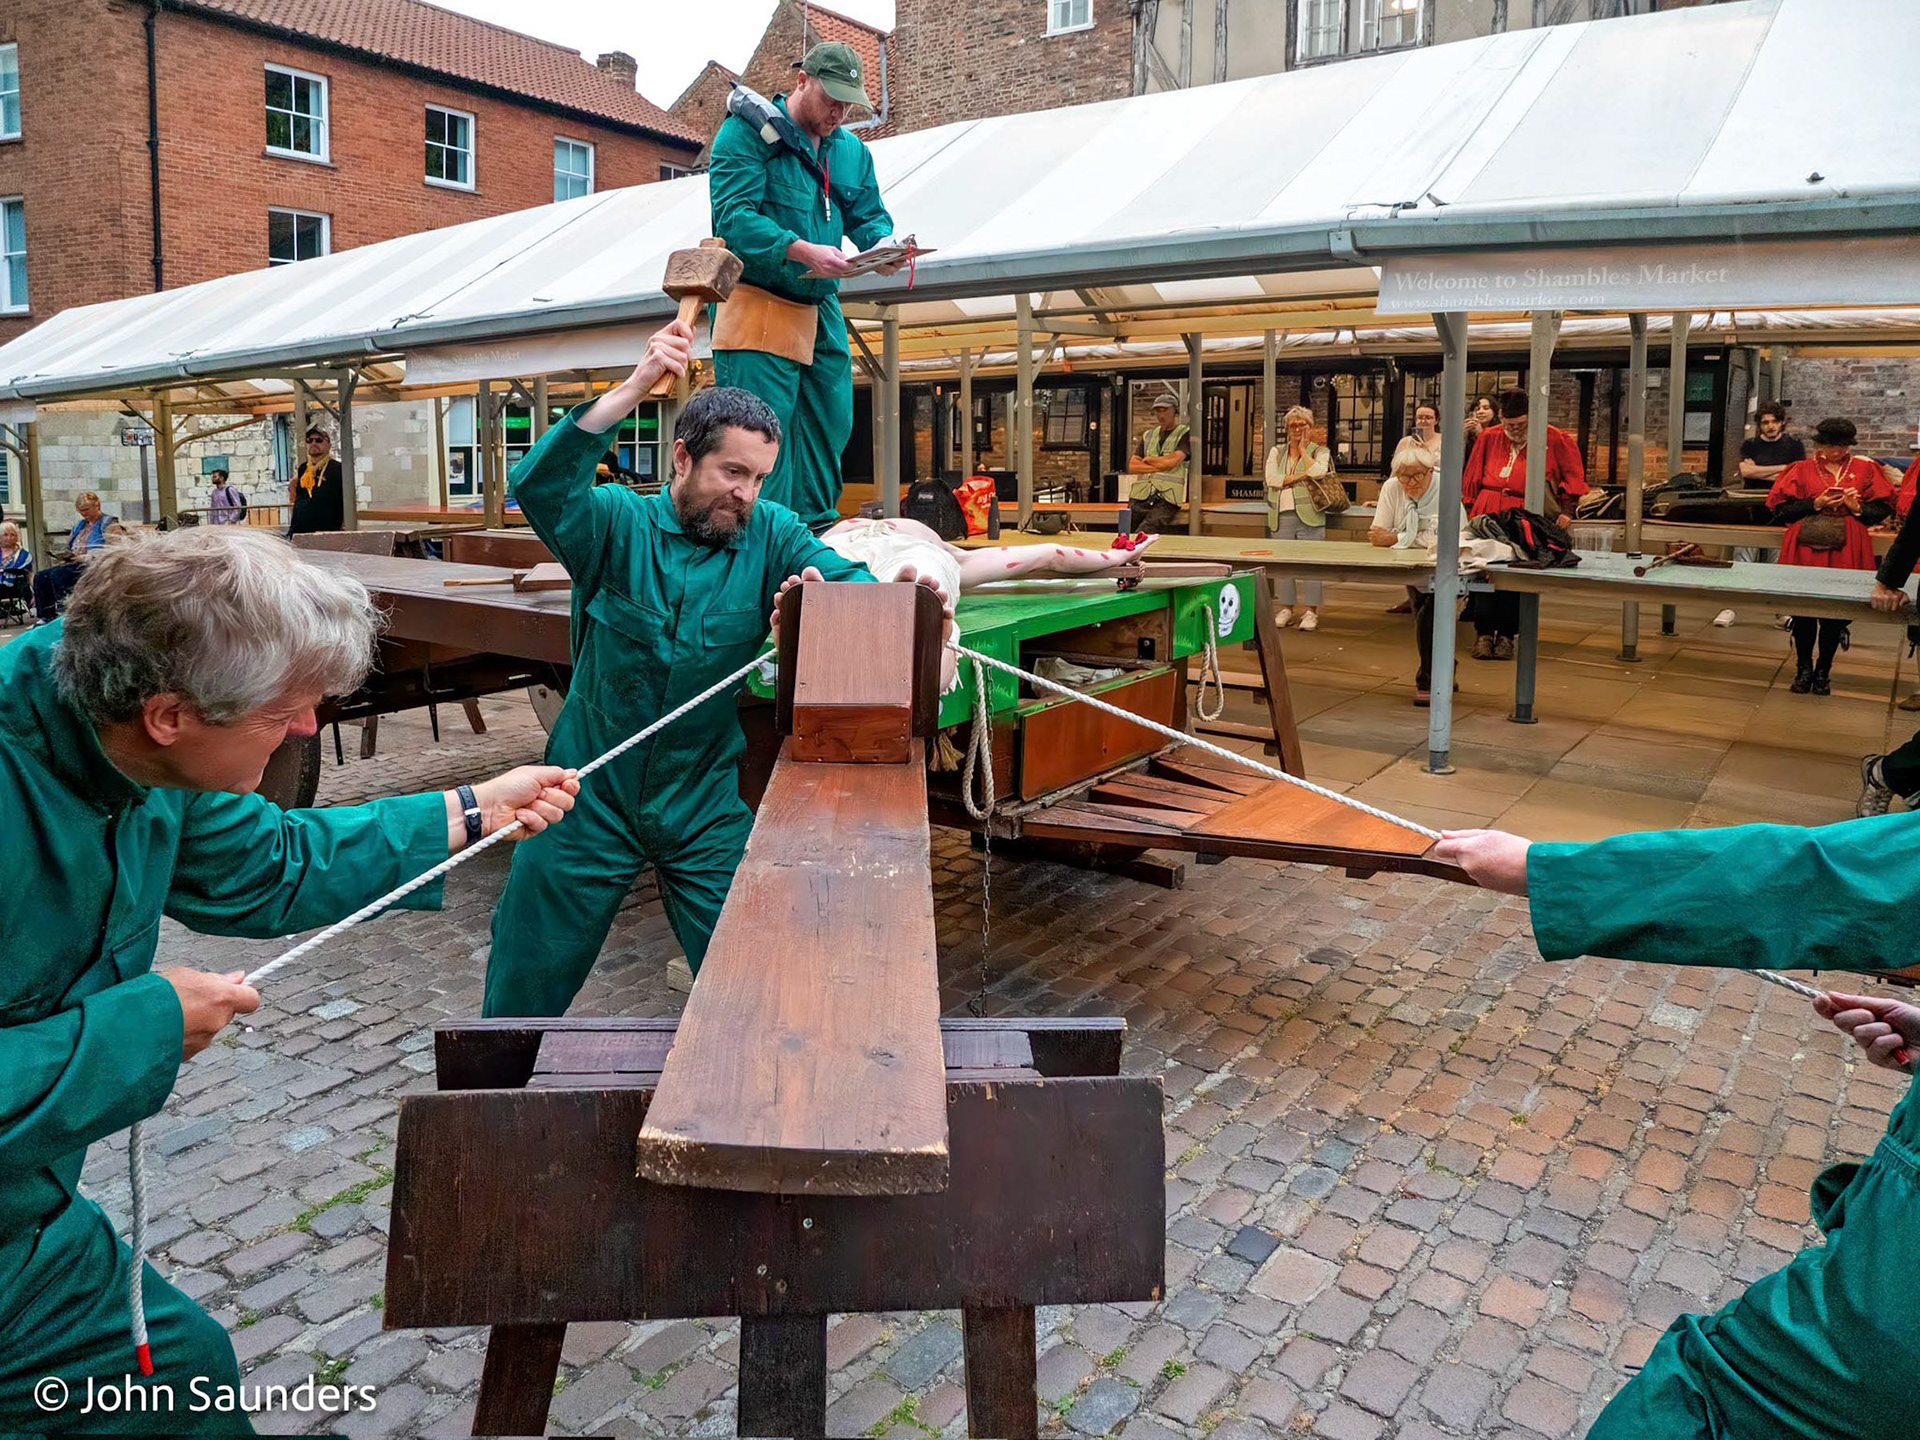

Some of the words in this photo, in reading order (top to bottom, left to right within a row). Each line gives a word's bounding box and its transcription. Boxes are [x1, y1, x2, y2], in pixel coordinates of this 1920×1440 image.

[1395, 273, 1488, 292] Welcome
[1496, 275, 1515, 288] to
[1523, 267, 1630, 287] Shambles
[1638, 264, 1729, 286] Market
[1391, 293, 1605, 308] www.shamblesmarket.com
